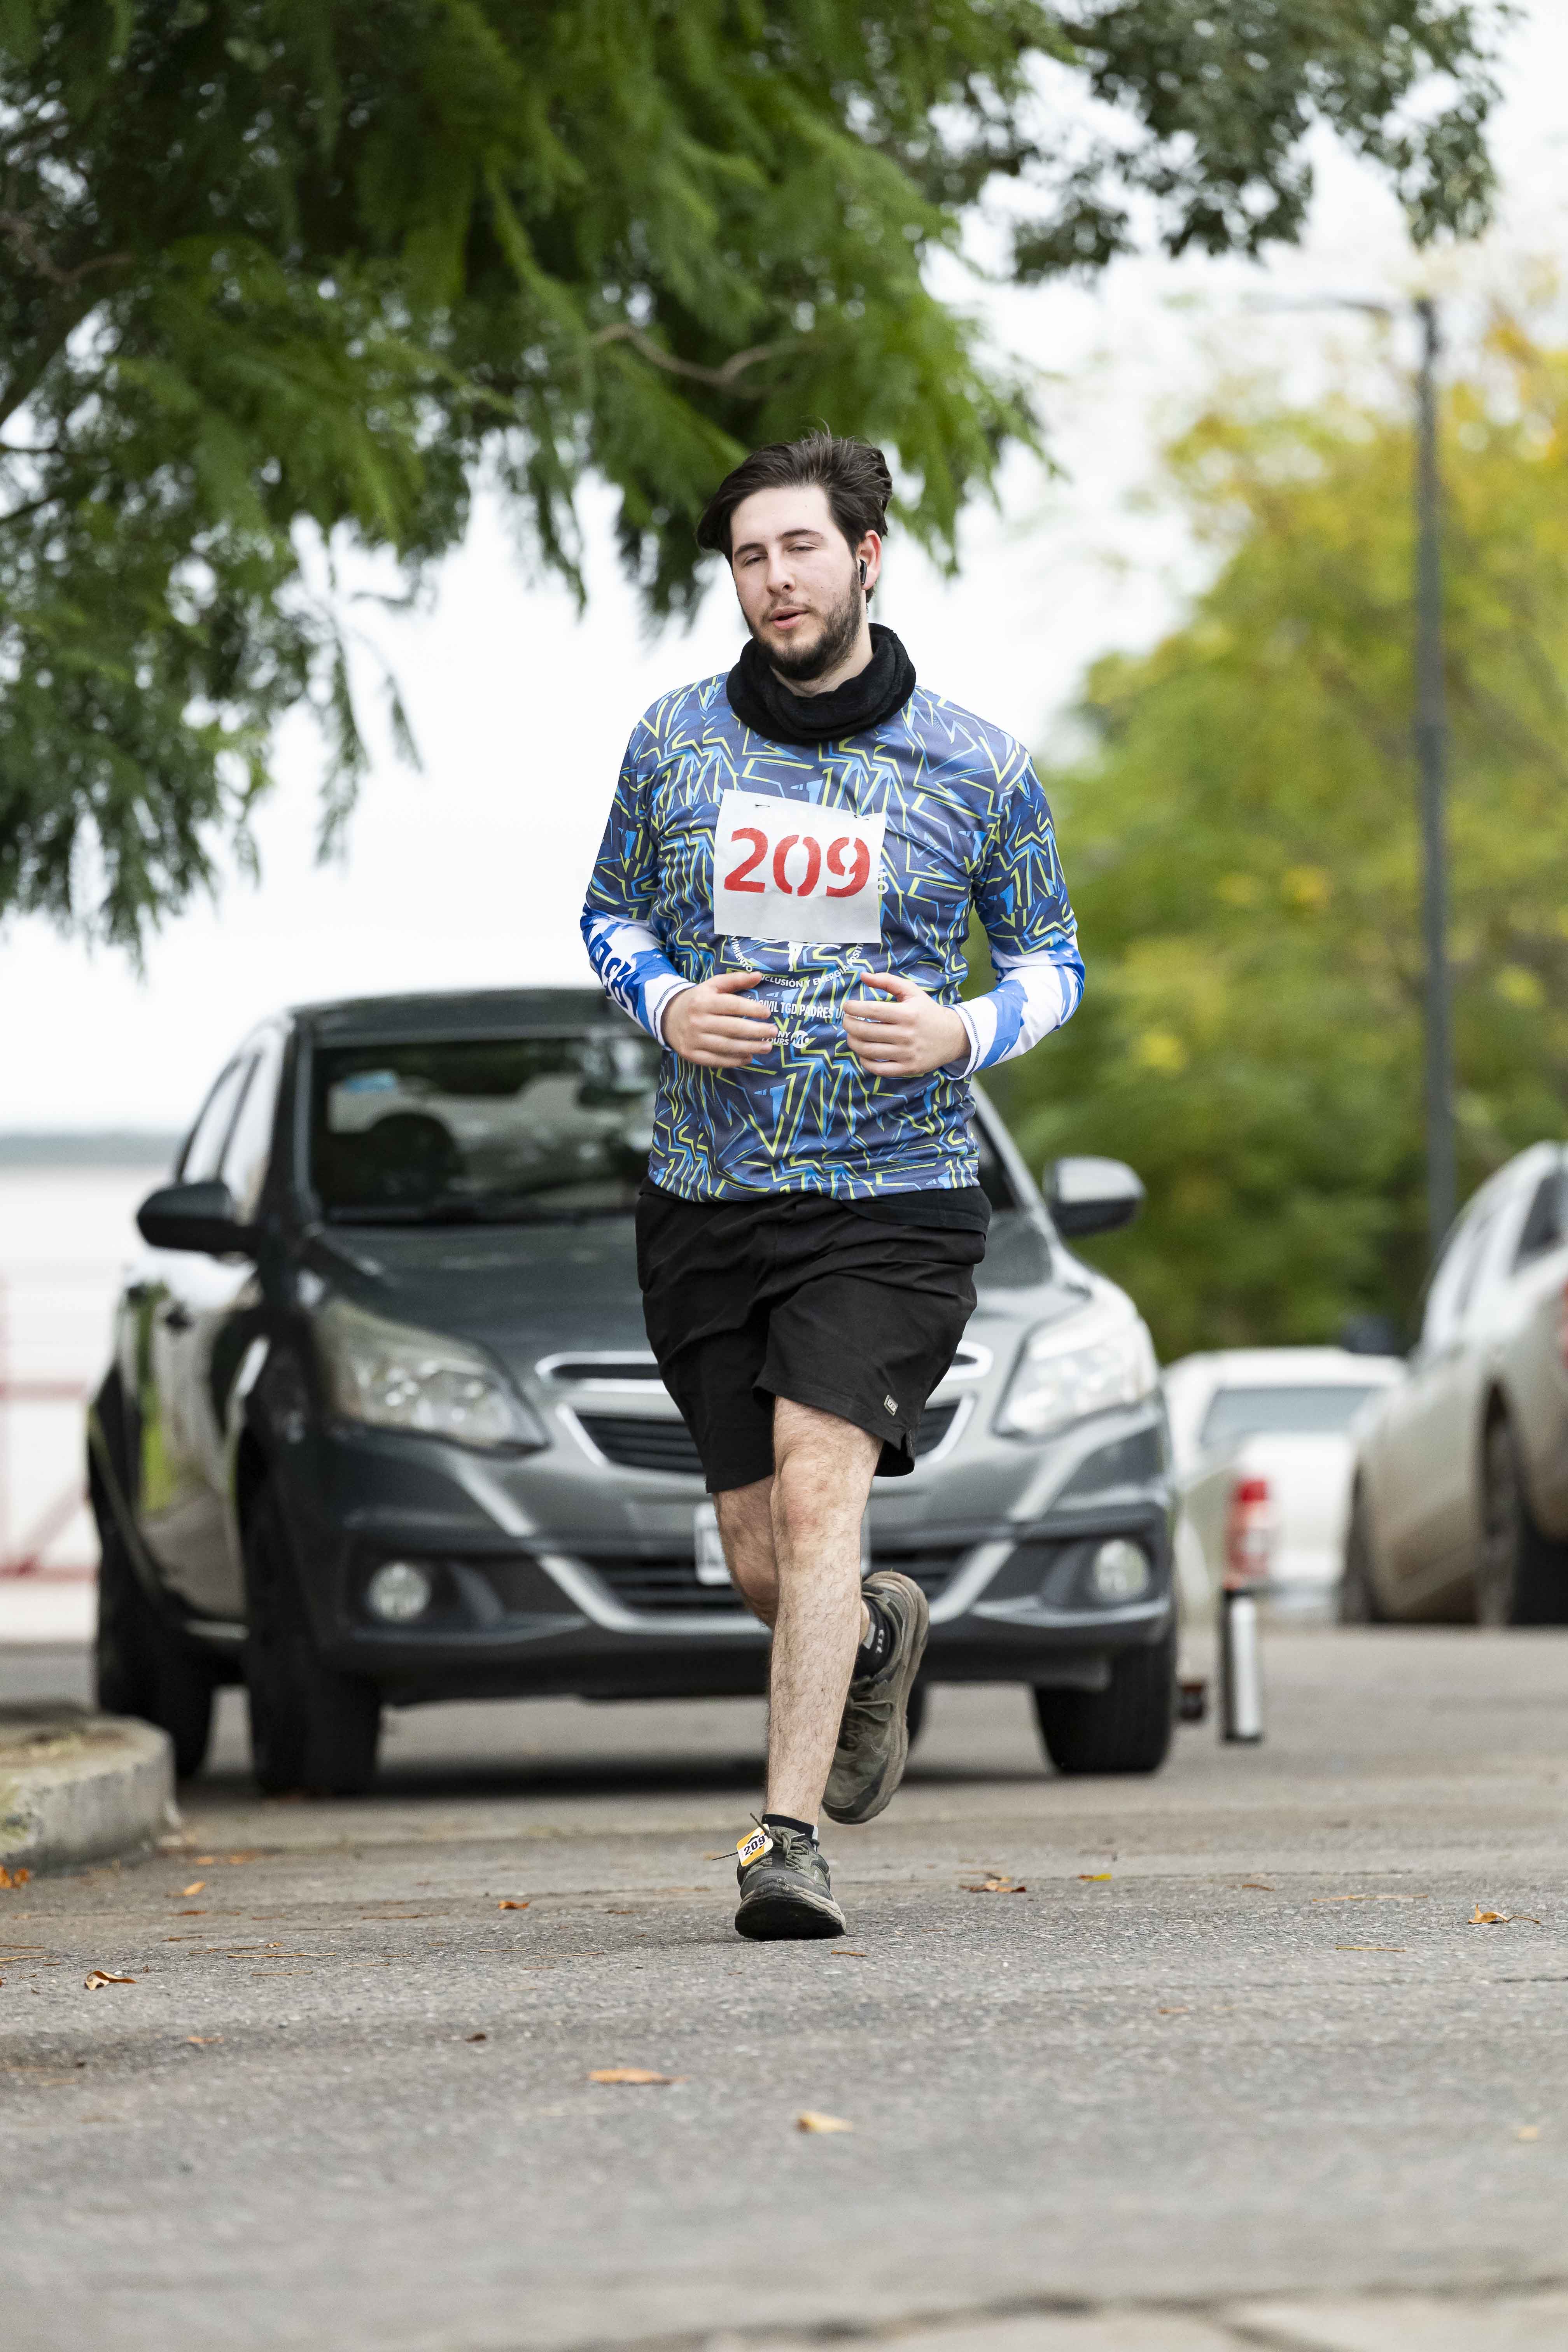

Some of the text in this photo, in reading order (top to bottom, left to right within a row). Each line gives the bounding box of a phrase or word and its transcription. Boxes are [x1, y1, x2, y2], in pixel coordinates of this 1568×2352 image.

[724, 828, 870, 898] 209
[730, 936, 753, 972] VIMIENTO
[761, 976, 803, 988] NCLUSIÓN
[847, 943, 863, 965] POSITI
[780, 1002, 797, 1015] TGD
[799, 1004, 834, 1019] PADRES
[744, 1835, 765, 1856] 209
